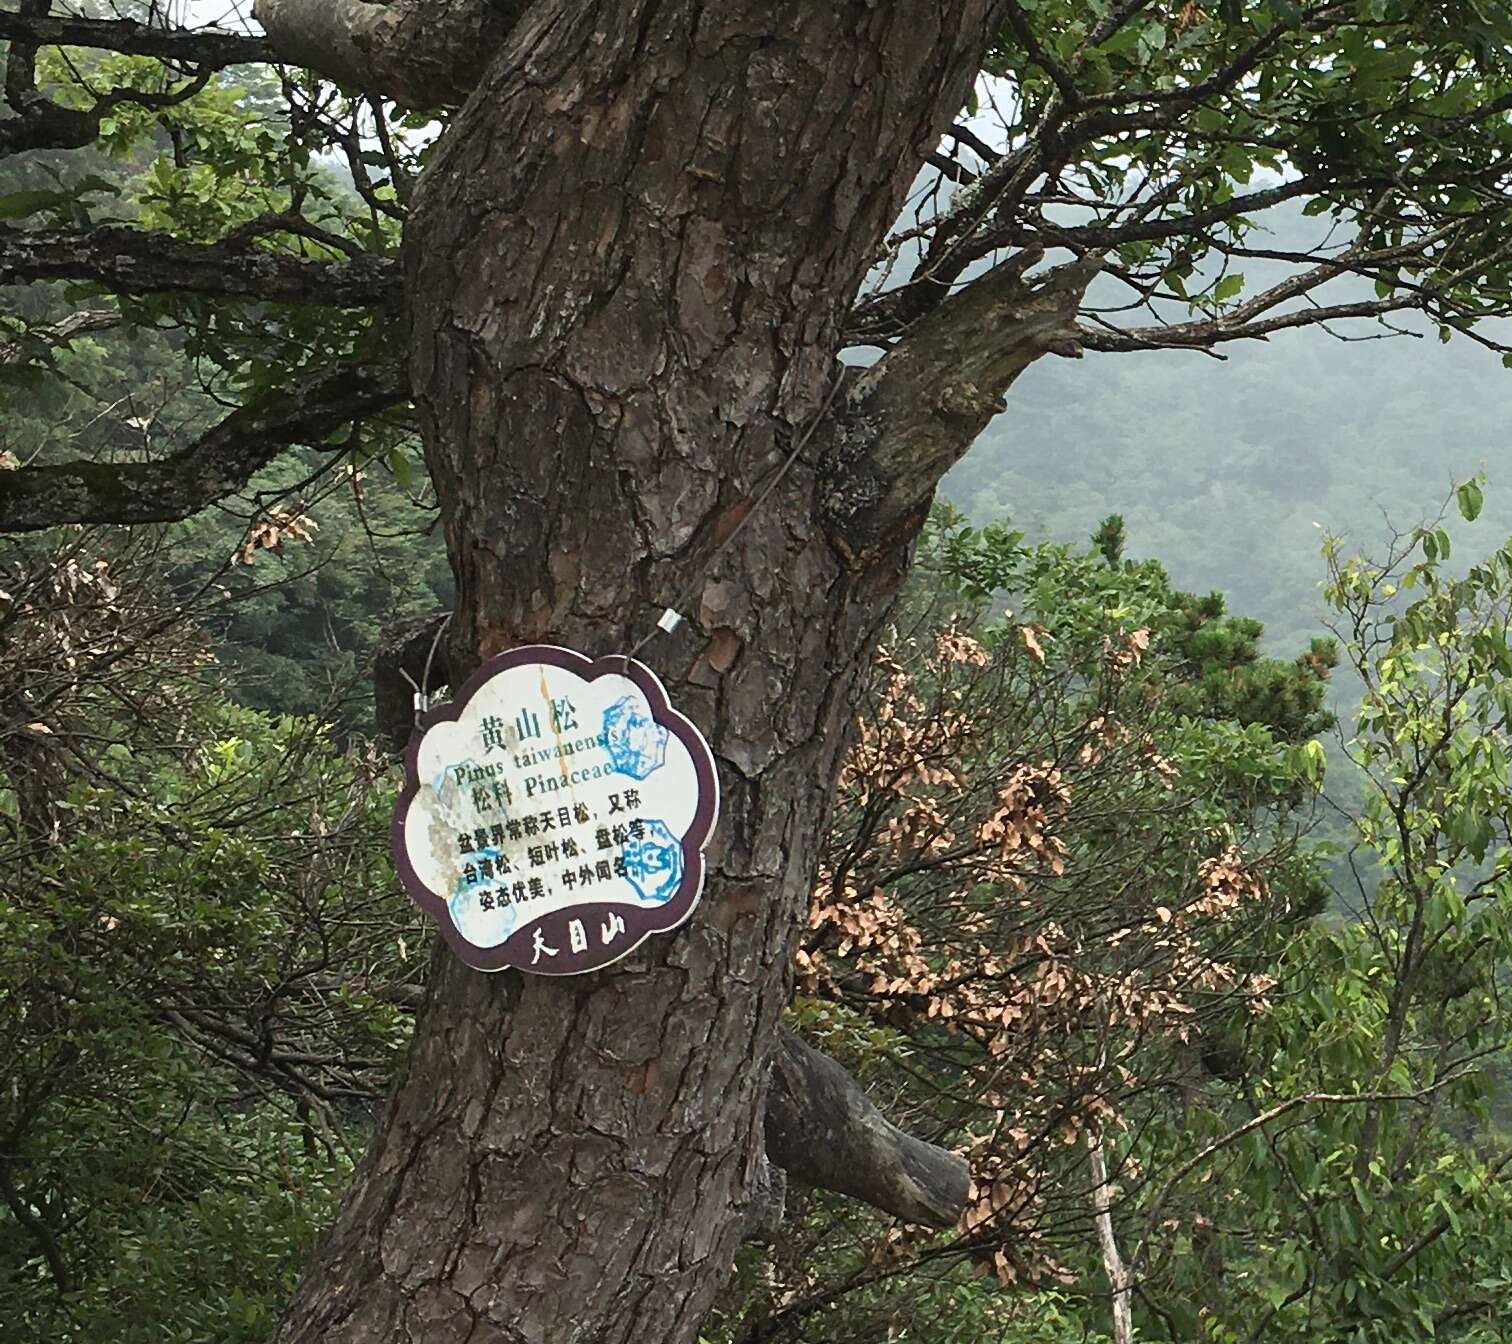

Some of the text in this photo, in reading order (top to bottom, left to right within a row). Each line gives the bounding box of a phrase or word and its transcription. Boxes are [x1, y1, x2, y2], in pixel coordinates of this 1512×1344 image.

[479, 694, 579, 756] 黄山松
[454, 760, 504, 788] Pinus
[471, 763, 613, 814] 松科 Pinaceae
[531, 912, 626, 964] 天目山
